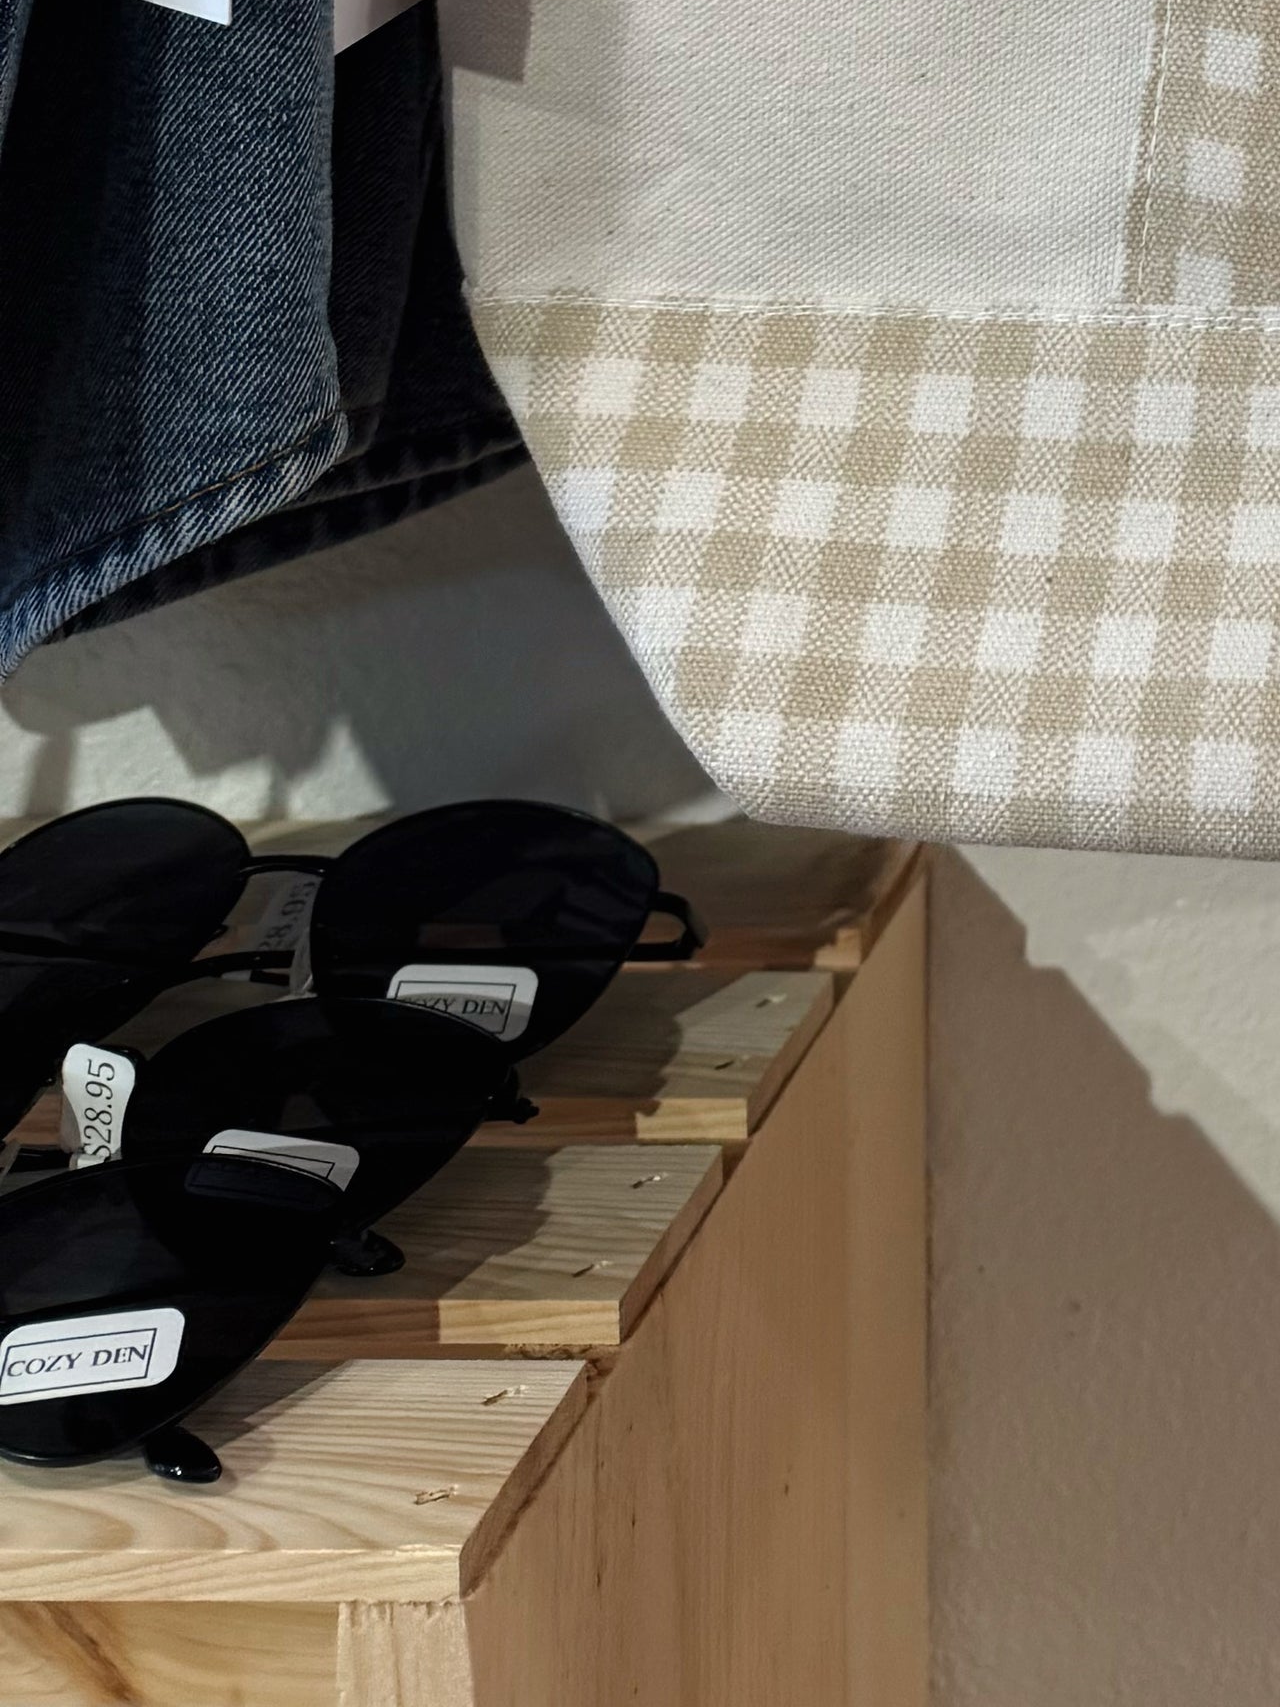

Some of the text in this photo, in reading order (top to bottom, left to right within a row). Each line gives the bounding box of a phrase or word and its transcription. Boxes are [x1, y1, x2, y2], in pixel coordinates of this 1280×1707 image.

[462, 999, 507, 1015] DEN
[7, 1344, 149, 1377] COZY DEN
